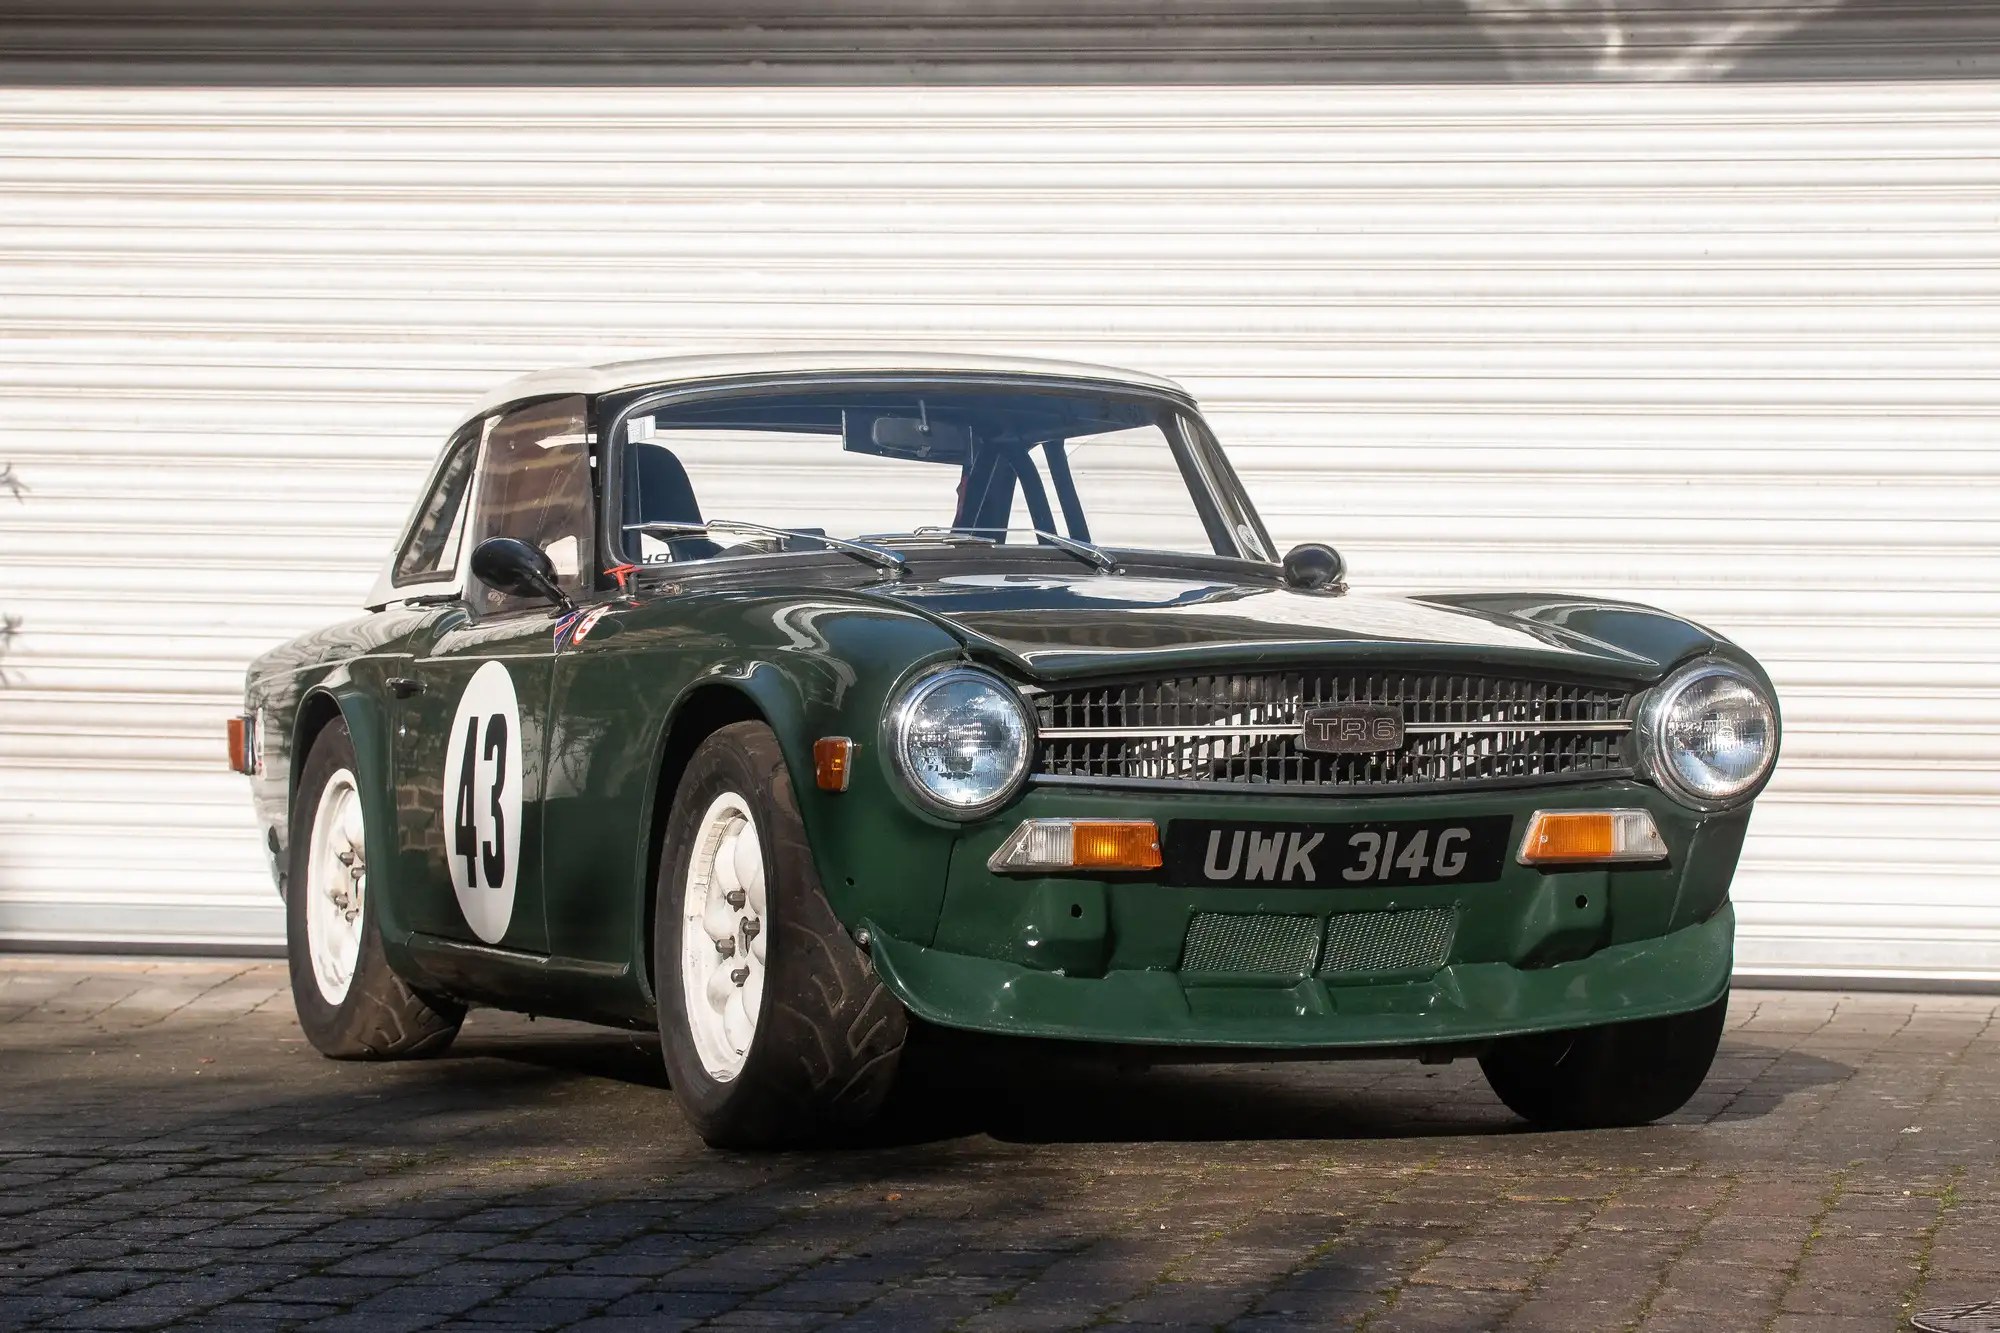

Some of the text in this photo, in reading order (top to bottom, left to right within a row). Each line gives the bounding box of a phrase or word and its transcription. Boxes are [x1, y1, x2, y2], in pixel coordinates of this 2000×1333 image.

[1312, 717, 1396, 741] TR6
[455, 713, 508, 889] 43
[1203, 827, 1471, 882] UWK 314G
